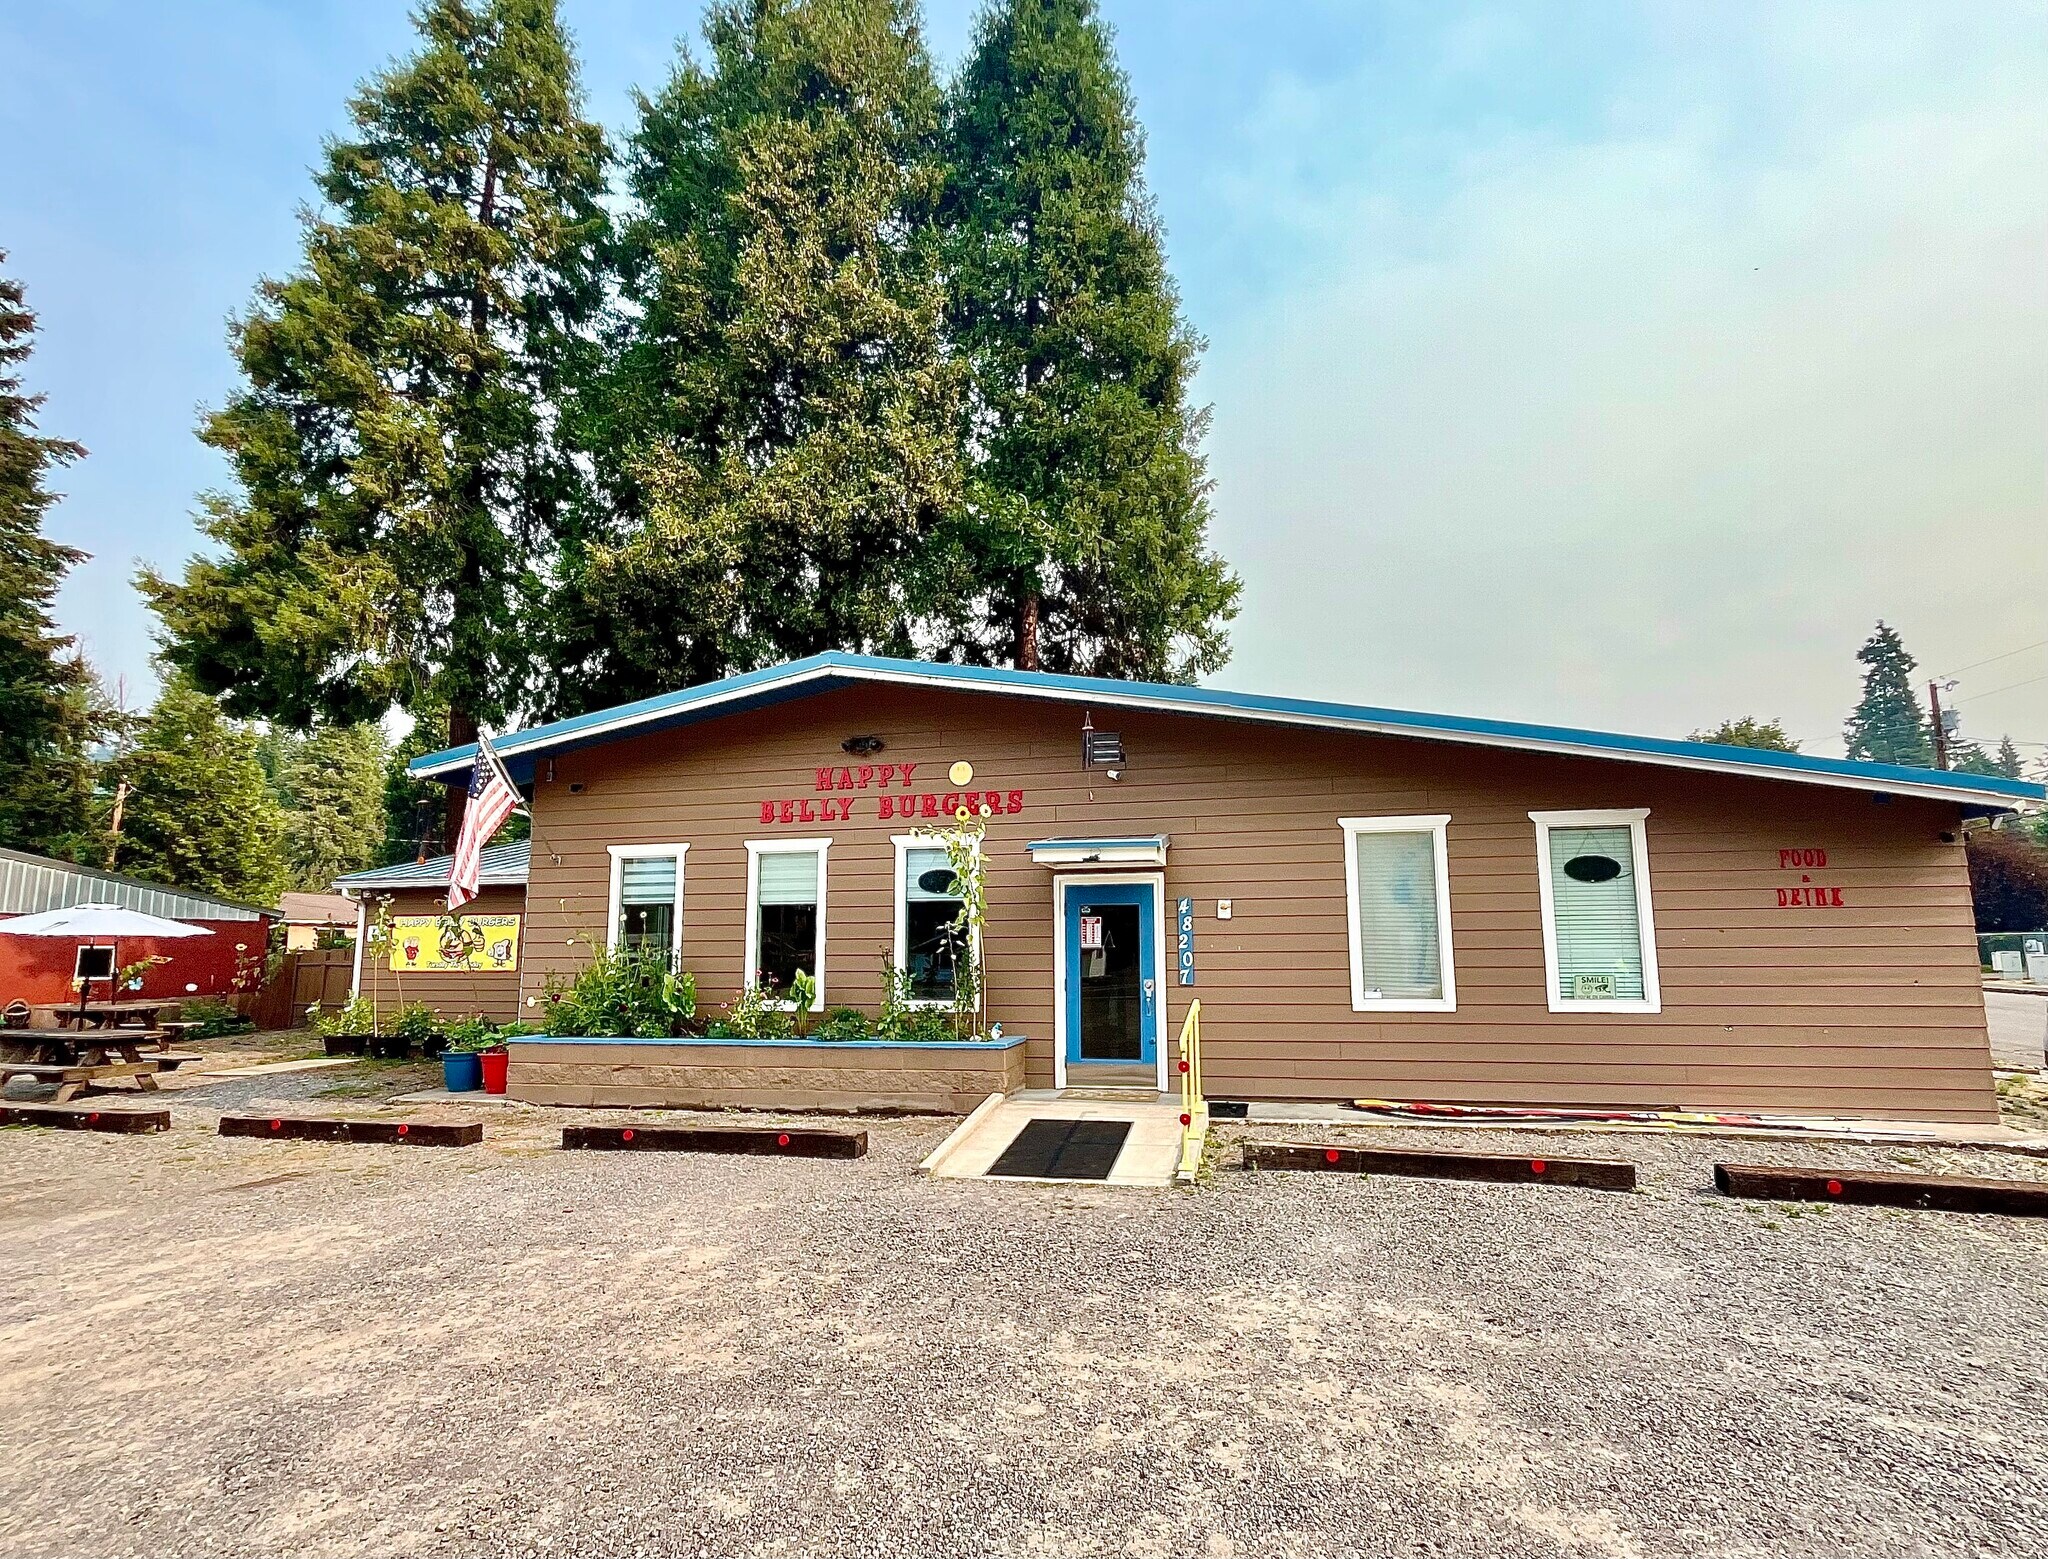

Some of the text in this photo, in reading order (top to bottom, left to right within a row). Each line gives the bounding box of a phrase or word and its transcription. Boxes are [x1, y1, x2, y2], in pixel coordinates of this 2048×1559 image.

[815, 764, 917, 791] HAPPY
[760, 790, 1024, 823] BELLY BURGERS
[1779, 848, 1827, 868] FOOD
[1776, 887, 1844, 907] DRINK
[399, 917, 432, 928] HAPPY
[1178, 897, 1194, 984] 48207
[1581, 976, 1609, 984] SMILE!
